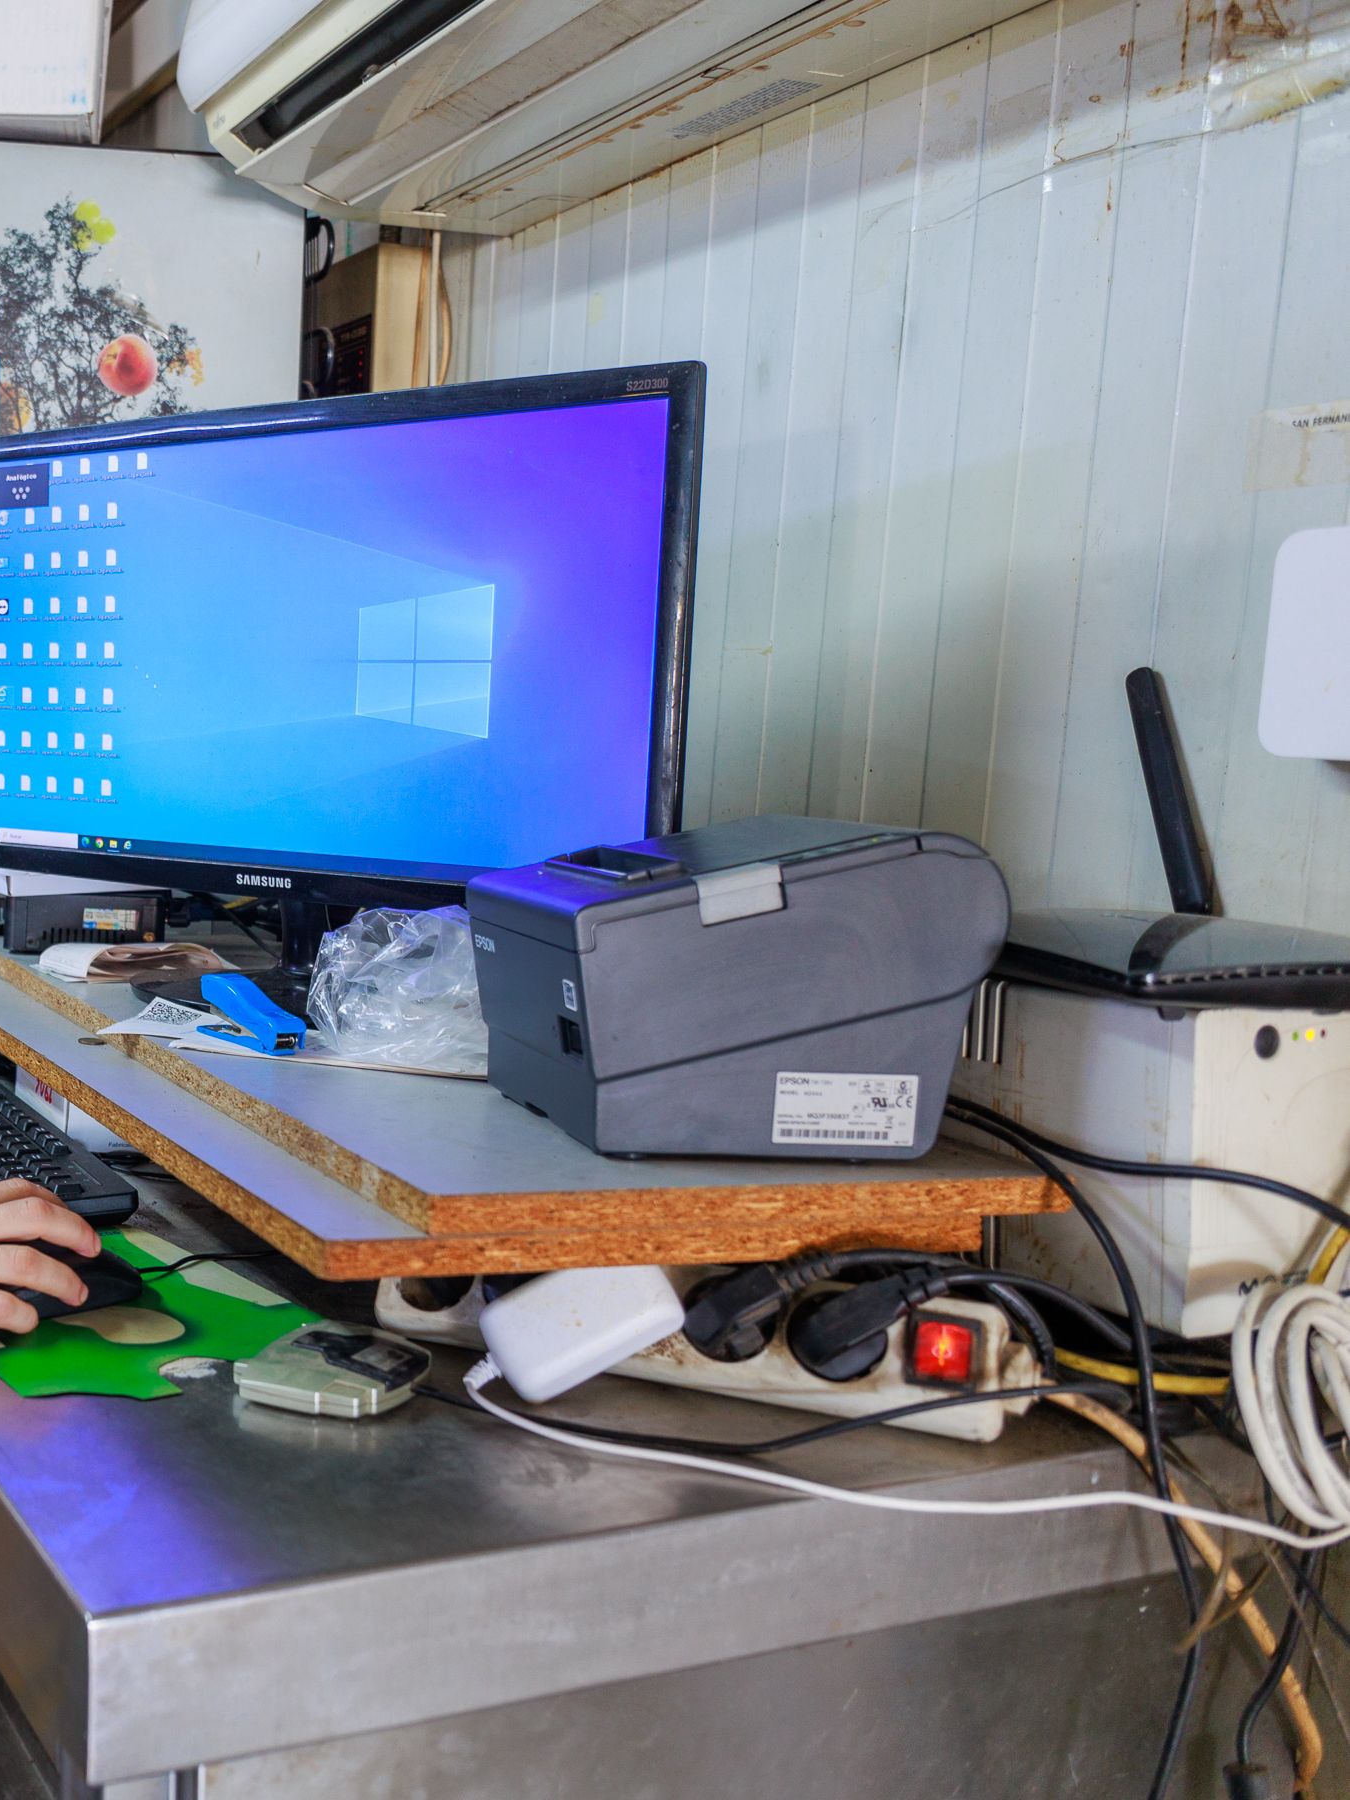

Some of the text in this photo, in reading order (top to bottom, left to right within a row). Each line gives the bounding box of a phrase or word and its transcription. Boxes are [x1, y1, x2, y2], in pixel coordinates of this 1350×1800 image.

[1292, 418, 1310, 428] SAN
[236, 873, 292, 889] SAMSUNG
[474, 933, 496, 953] EPSON
[779, 1076, 810, 1087] EPSON
